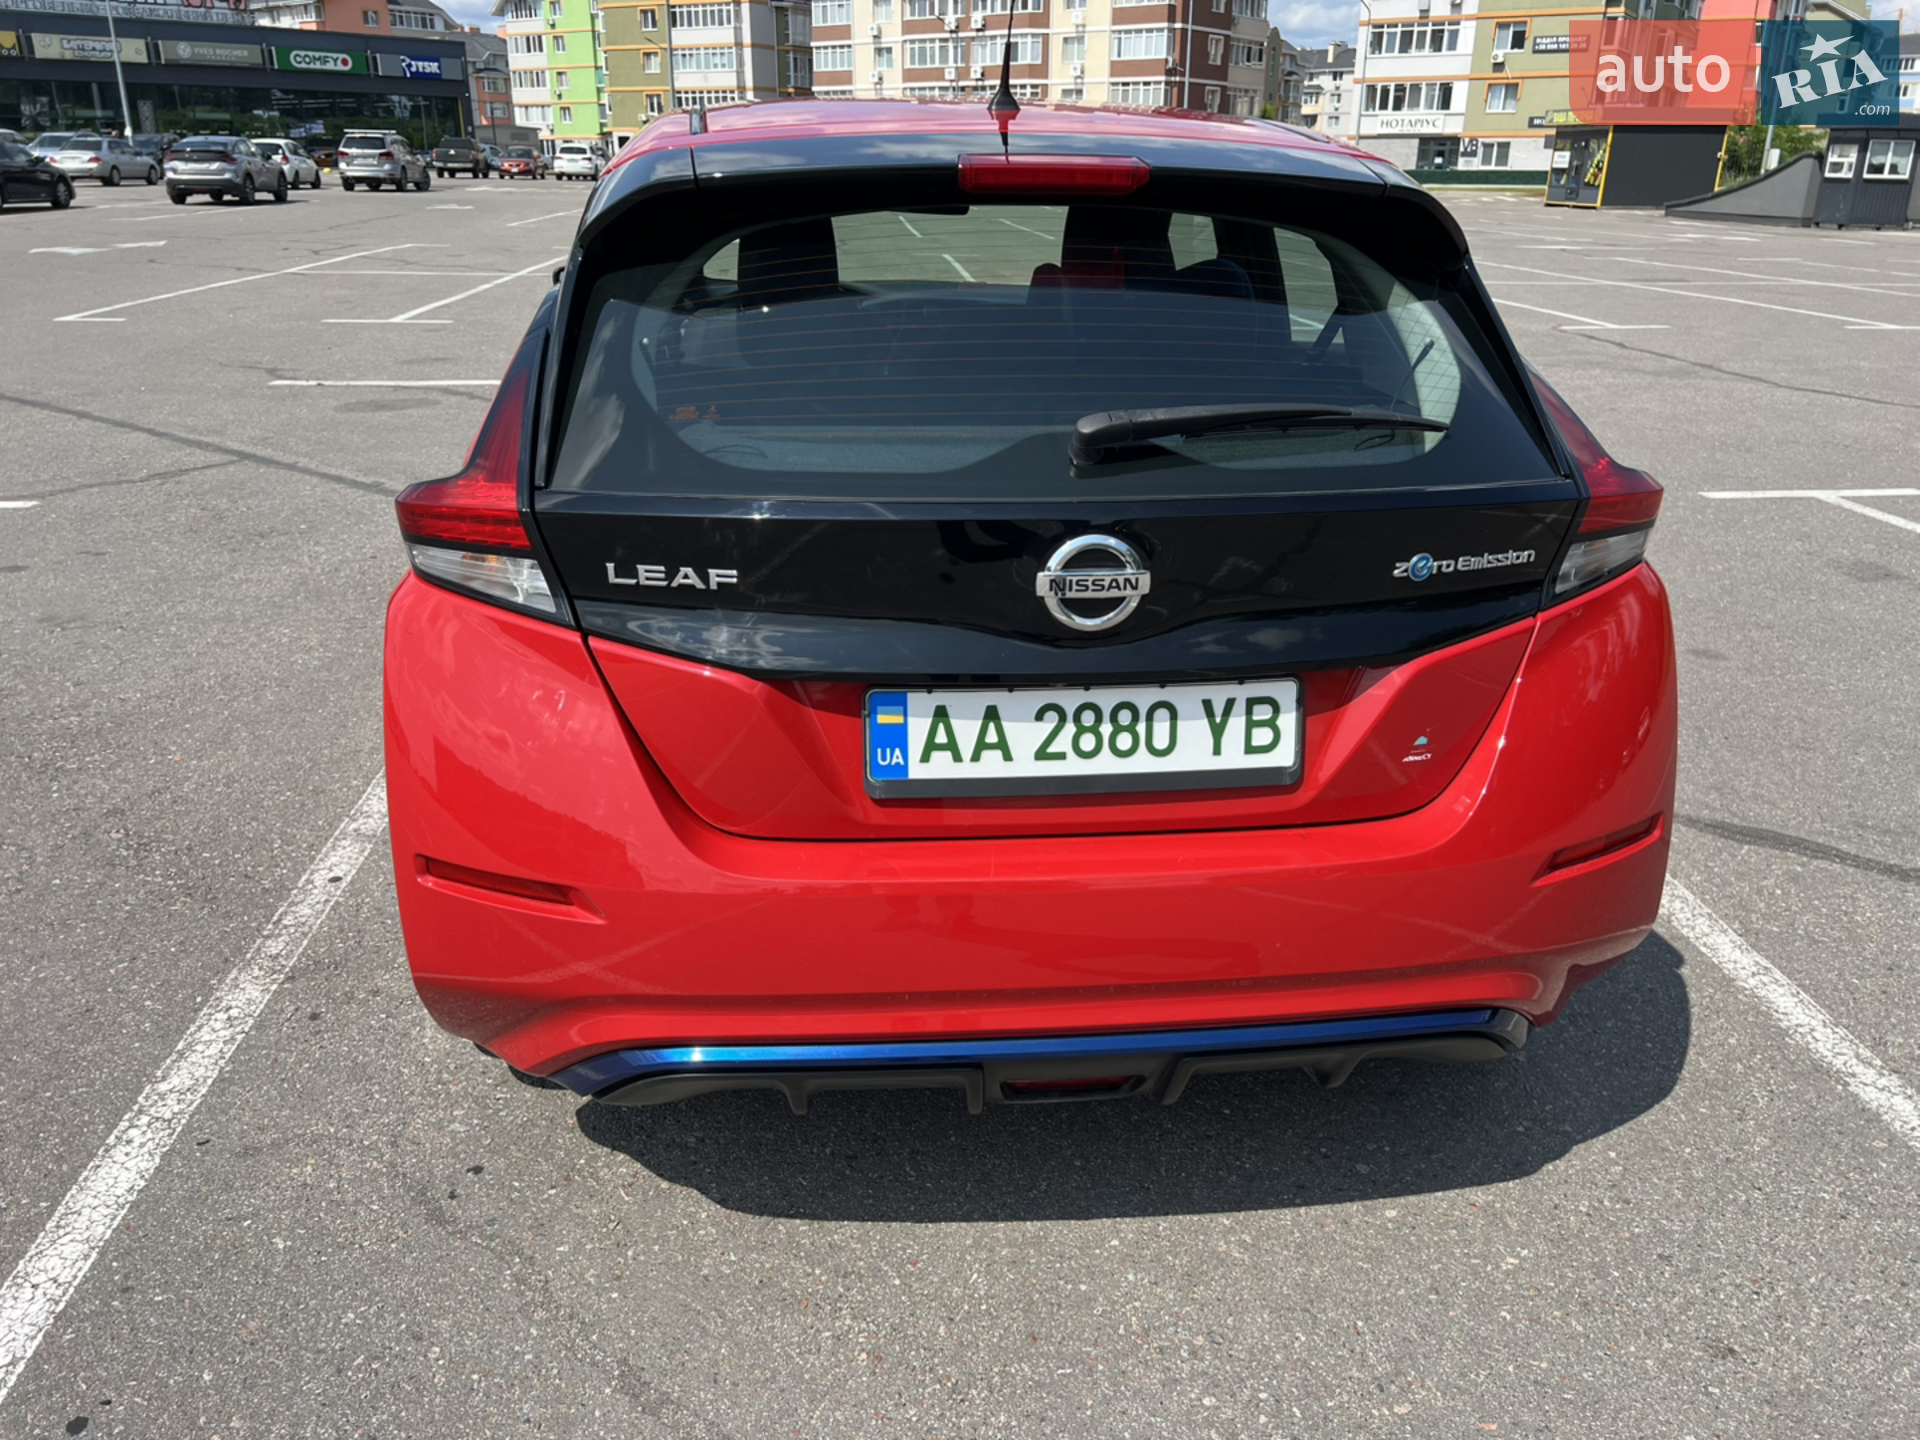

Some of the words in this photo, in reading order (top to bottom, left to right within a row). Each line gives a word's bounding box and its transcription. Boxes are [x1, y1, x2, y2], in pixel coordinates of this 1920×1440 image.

[194, 47, 213, 55] YVES
[215, 49, 249, 57] ROCHER
[293, 53, 340, 67] COMFY
[410, 60, 441, 74] JYSK
[1380, 117, 1441, 129] НОТАРІУС
[605, 562, 738, 590] LEAF
[1048, 576, 1140, 594] NISSAN
[919, 704, 1013, 763] AA
[1034, 699, 1178, 761] 2880
[1201, 695, 1281, 756] YB
[877, 747, 905, 766] UA
